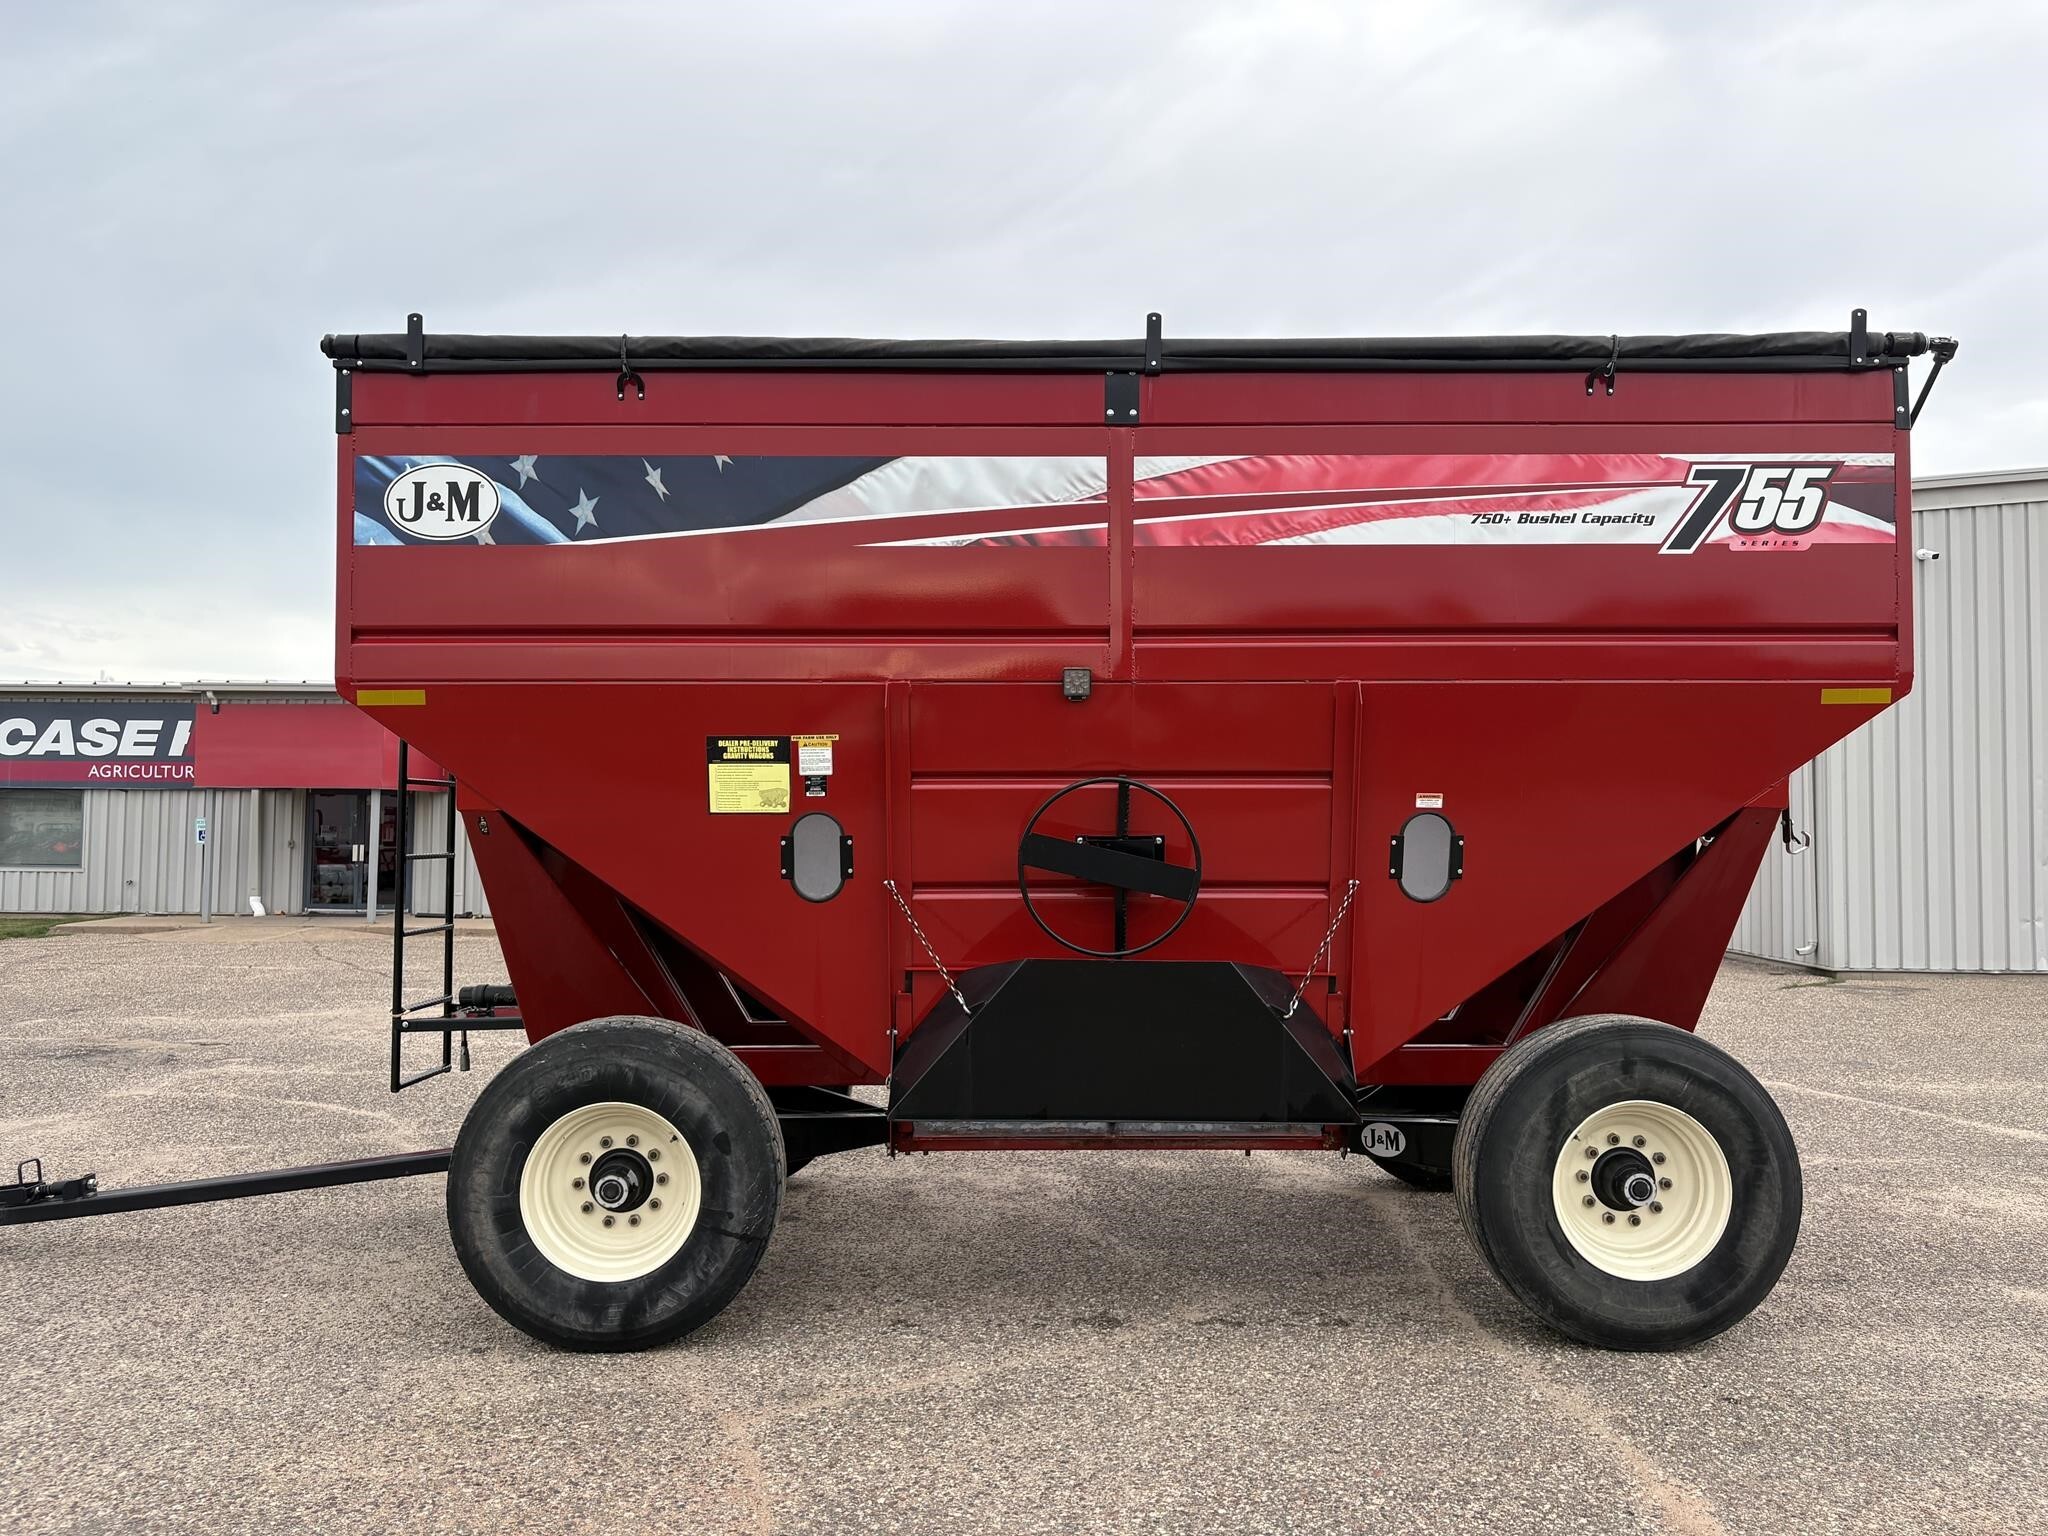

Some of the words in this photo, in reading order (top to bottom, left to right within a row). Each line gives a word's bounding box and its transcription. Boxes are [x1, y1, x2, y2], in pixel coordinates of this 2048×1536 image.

[396, 481, 482, 523] J&M
[1659, 464, 1837, 554] 755
[1470, 513, 1512, 525] 750+
[1517, 513, 1577, 525] Bushel
[1581, 512, 1656, 527] Capacity
[0, 718, 164, 756] CASE
[88, 765, 195, 779] AGRICULTUR
[1363, 1128, 1401, 1152] J&M
